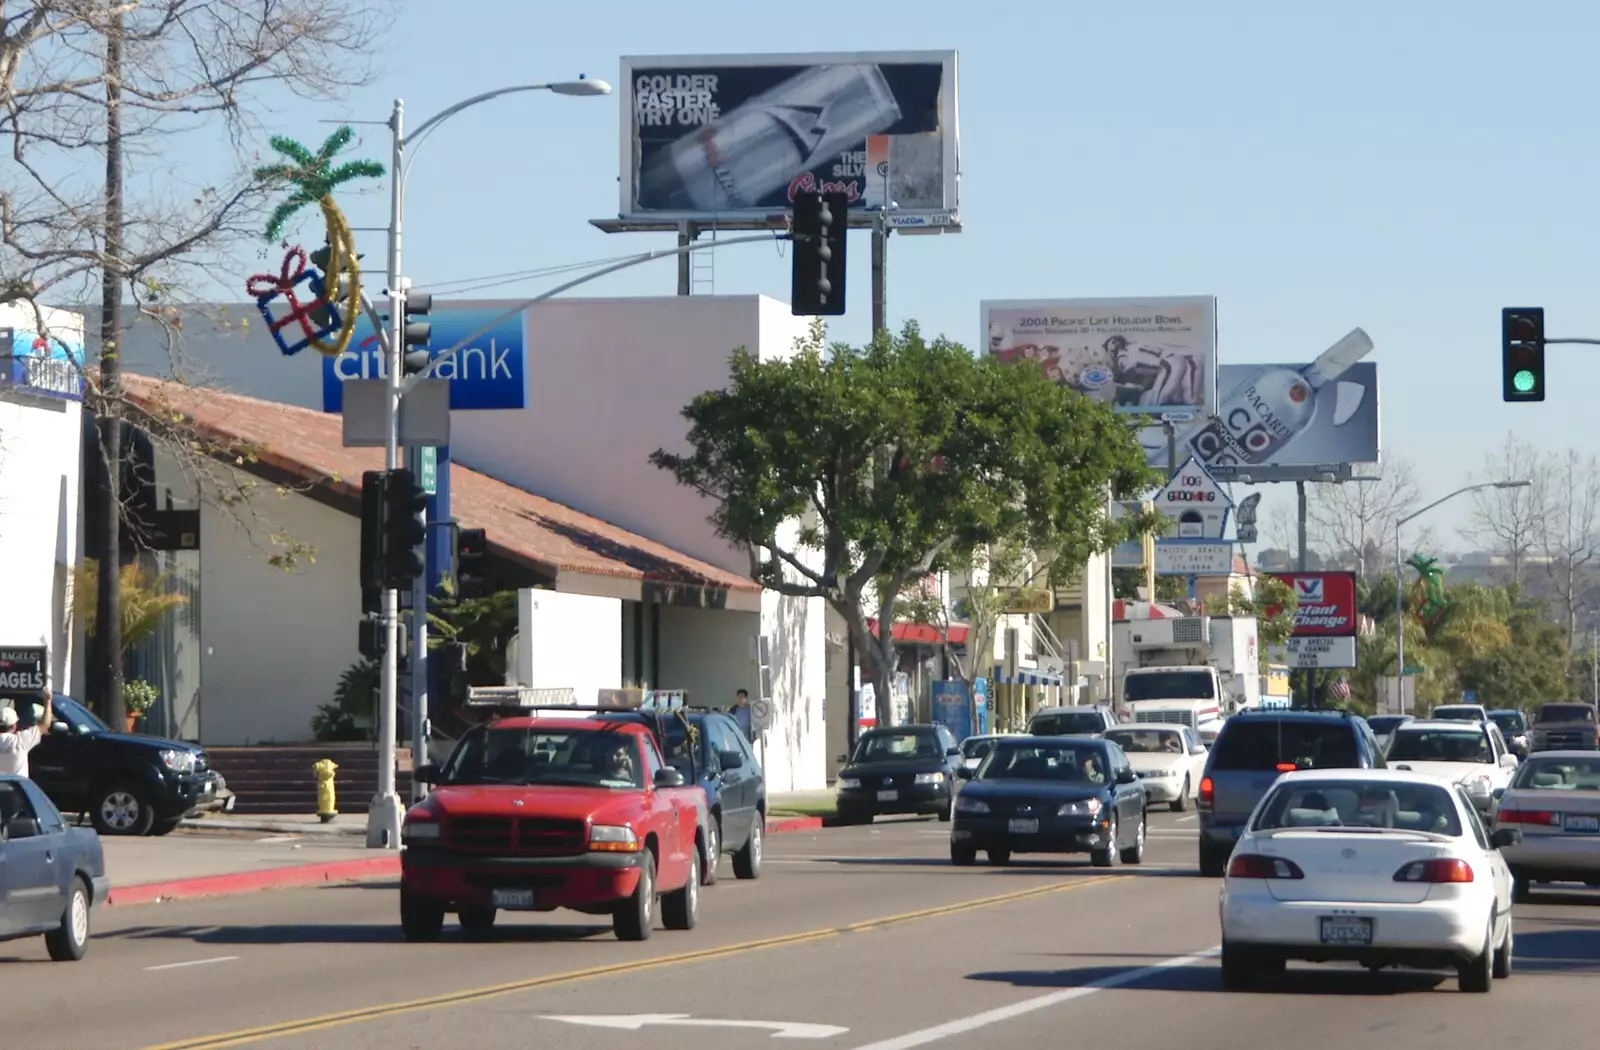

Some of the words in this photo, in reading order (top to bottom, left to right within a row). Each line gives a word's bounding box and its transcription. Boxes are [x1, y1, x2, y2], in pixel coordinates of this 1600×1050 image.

[637, 74, 718, 92] COLDER
[637, 91, 717, 109] FASTER.
[639, 108, 674, 125] TRY
[677, 108, 720, 125] ONE
[841, 152, 866, 163] THE
[1020, 317, 1048, 327] 2004
[333, 338, 513, 381] citank
[1181, 475, 1202, 486] DOG
[1283, 605, 1338, 616] stant
[0, 671, 44, 689] AGELS
